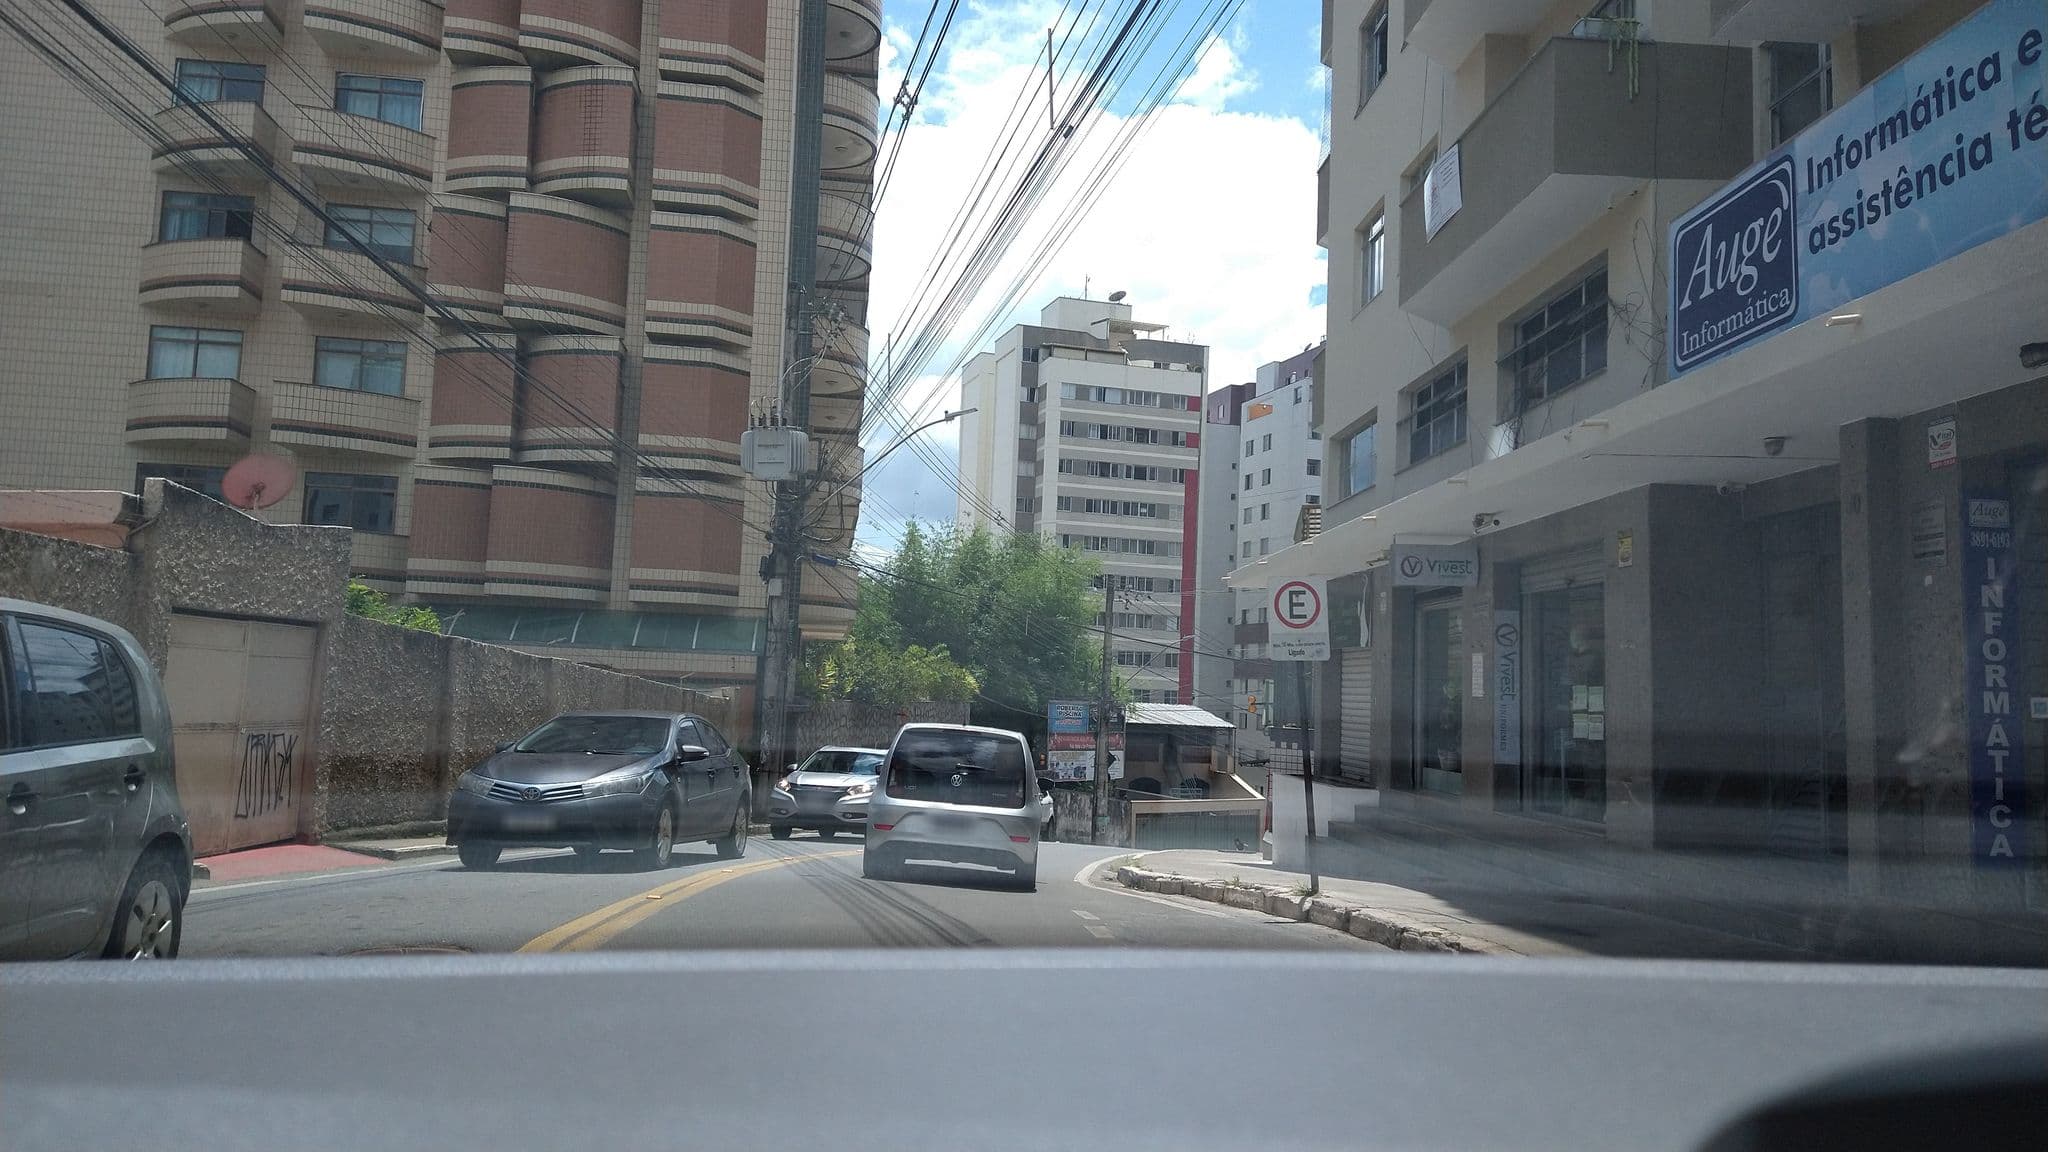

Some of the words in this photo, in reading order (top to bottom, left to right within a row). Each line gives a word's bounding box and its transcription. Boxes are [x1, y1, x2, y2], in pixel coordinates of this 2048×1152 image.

[1807, 50, 2001, 194] Informática
[2018, 29, 2043, 66] e
[1809, 132, 1993, 255] assistência
[1679, 200, 1785, 310] Auge
[1681, 288, 1790, 356] Informática
[1427, 557, 1473, 574] Vivest
[1288, 590, 1308, 619] E
[1501, 651, 1517, 700] Vivest
